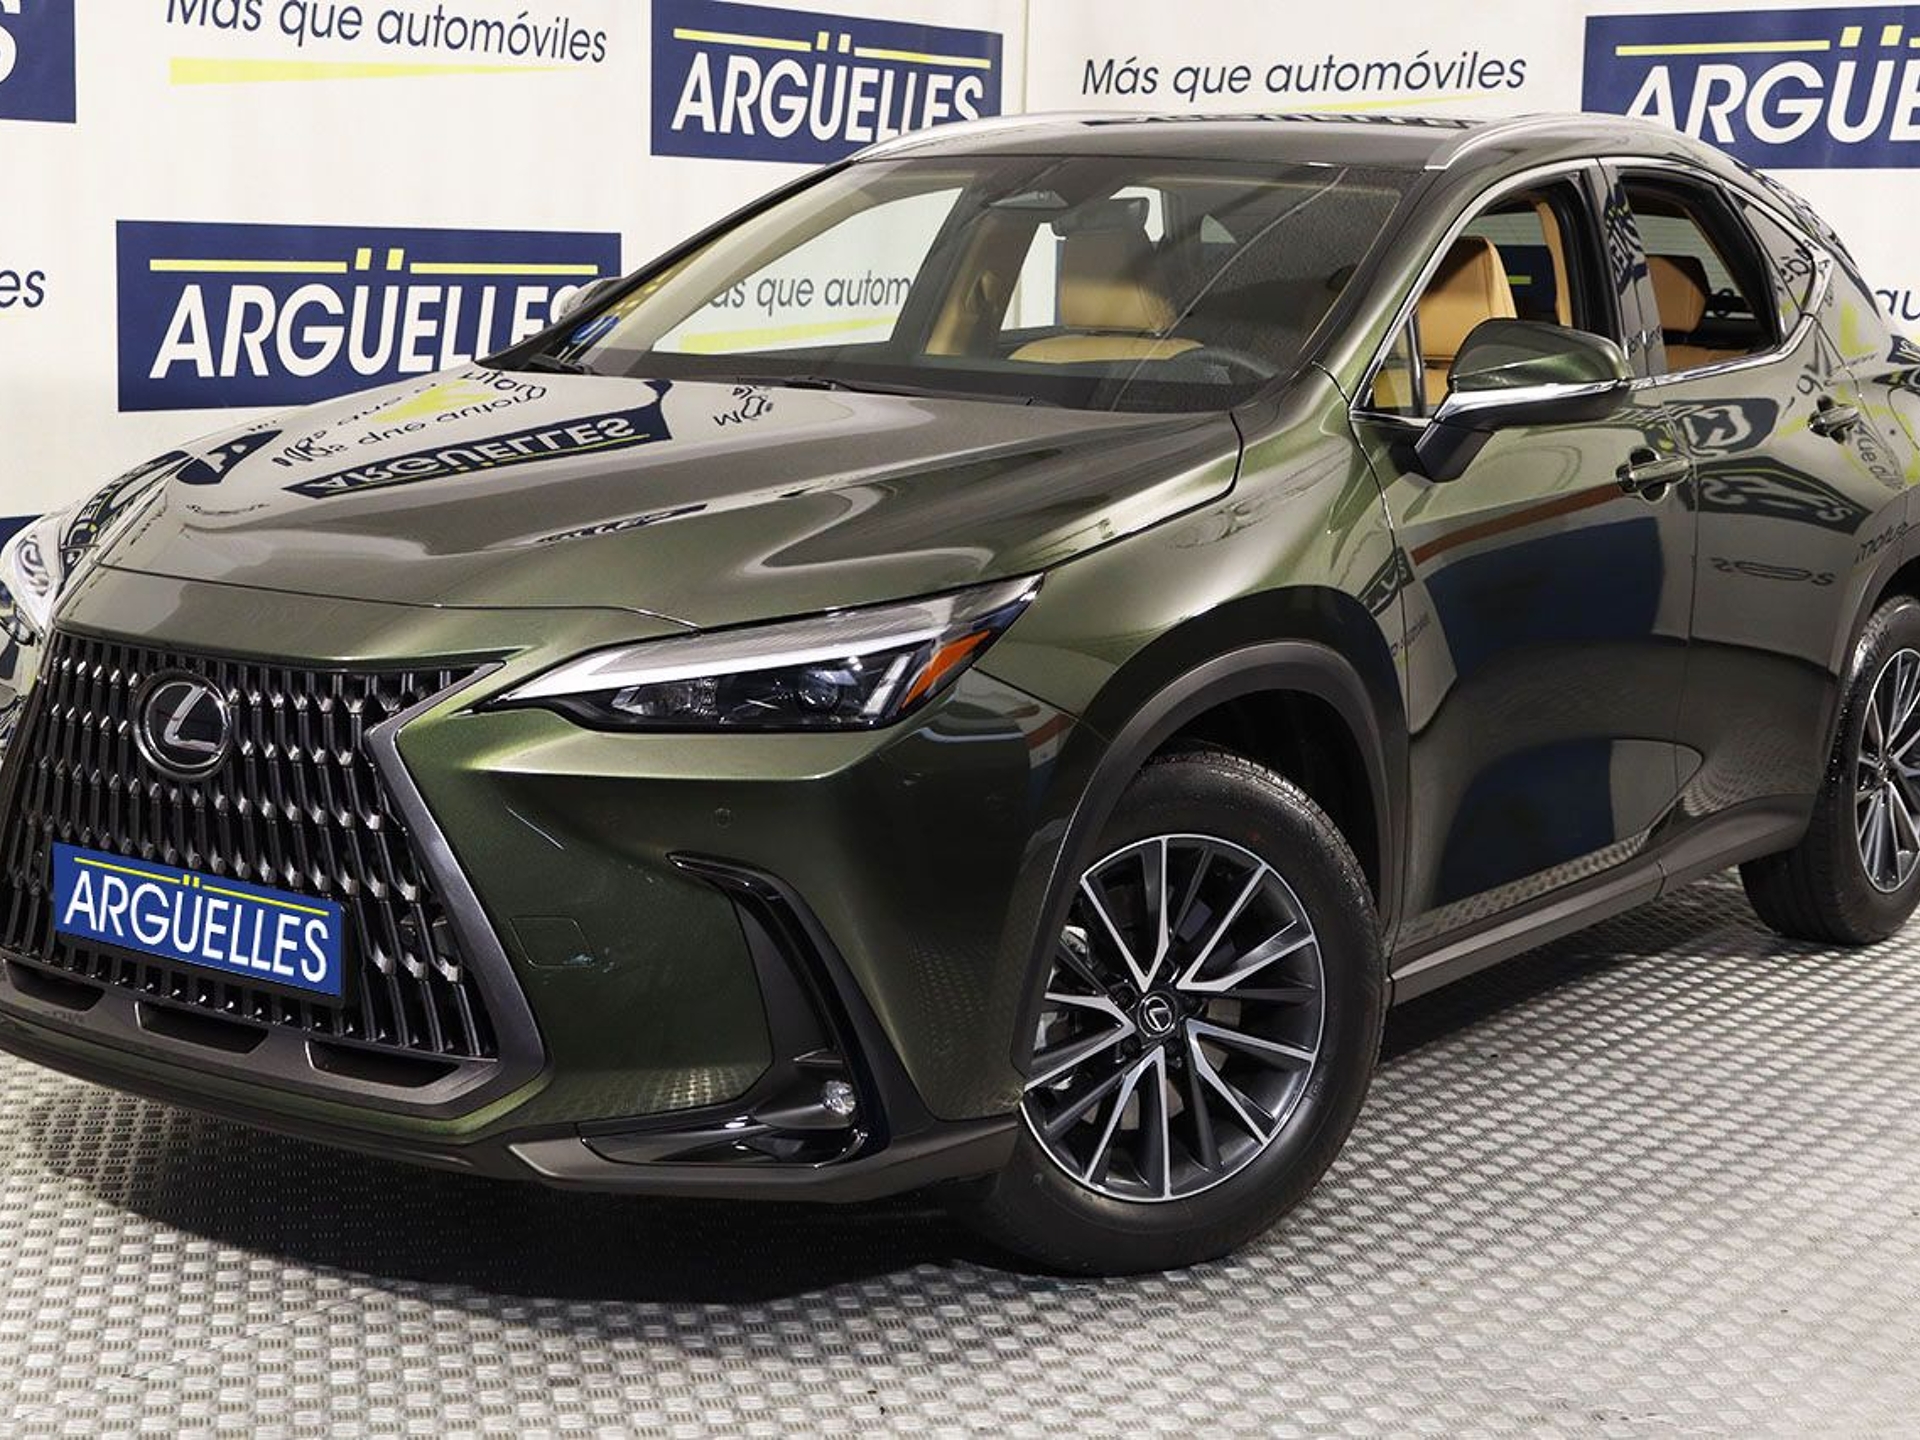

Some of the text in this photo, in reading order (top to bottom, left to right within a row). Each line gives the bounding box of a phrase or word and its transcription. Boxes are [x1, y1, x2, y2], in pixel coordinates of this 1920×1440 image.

[279, 0, 363, 47] que
[377, 5, 608, 62] automóviles
[1082, 50, 1527, 102] Más que automóviles
[149, 248, 579, 380] ARGÜELLE
[757, 277, 815, 317] que
[63, 870, 330, 984] ARGÜELLES
